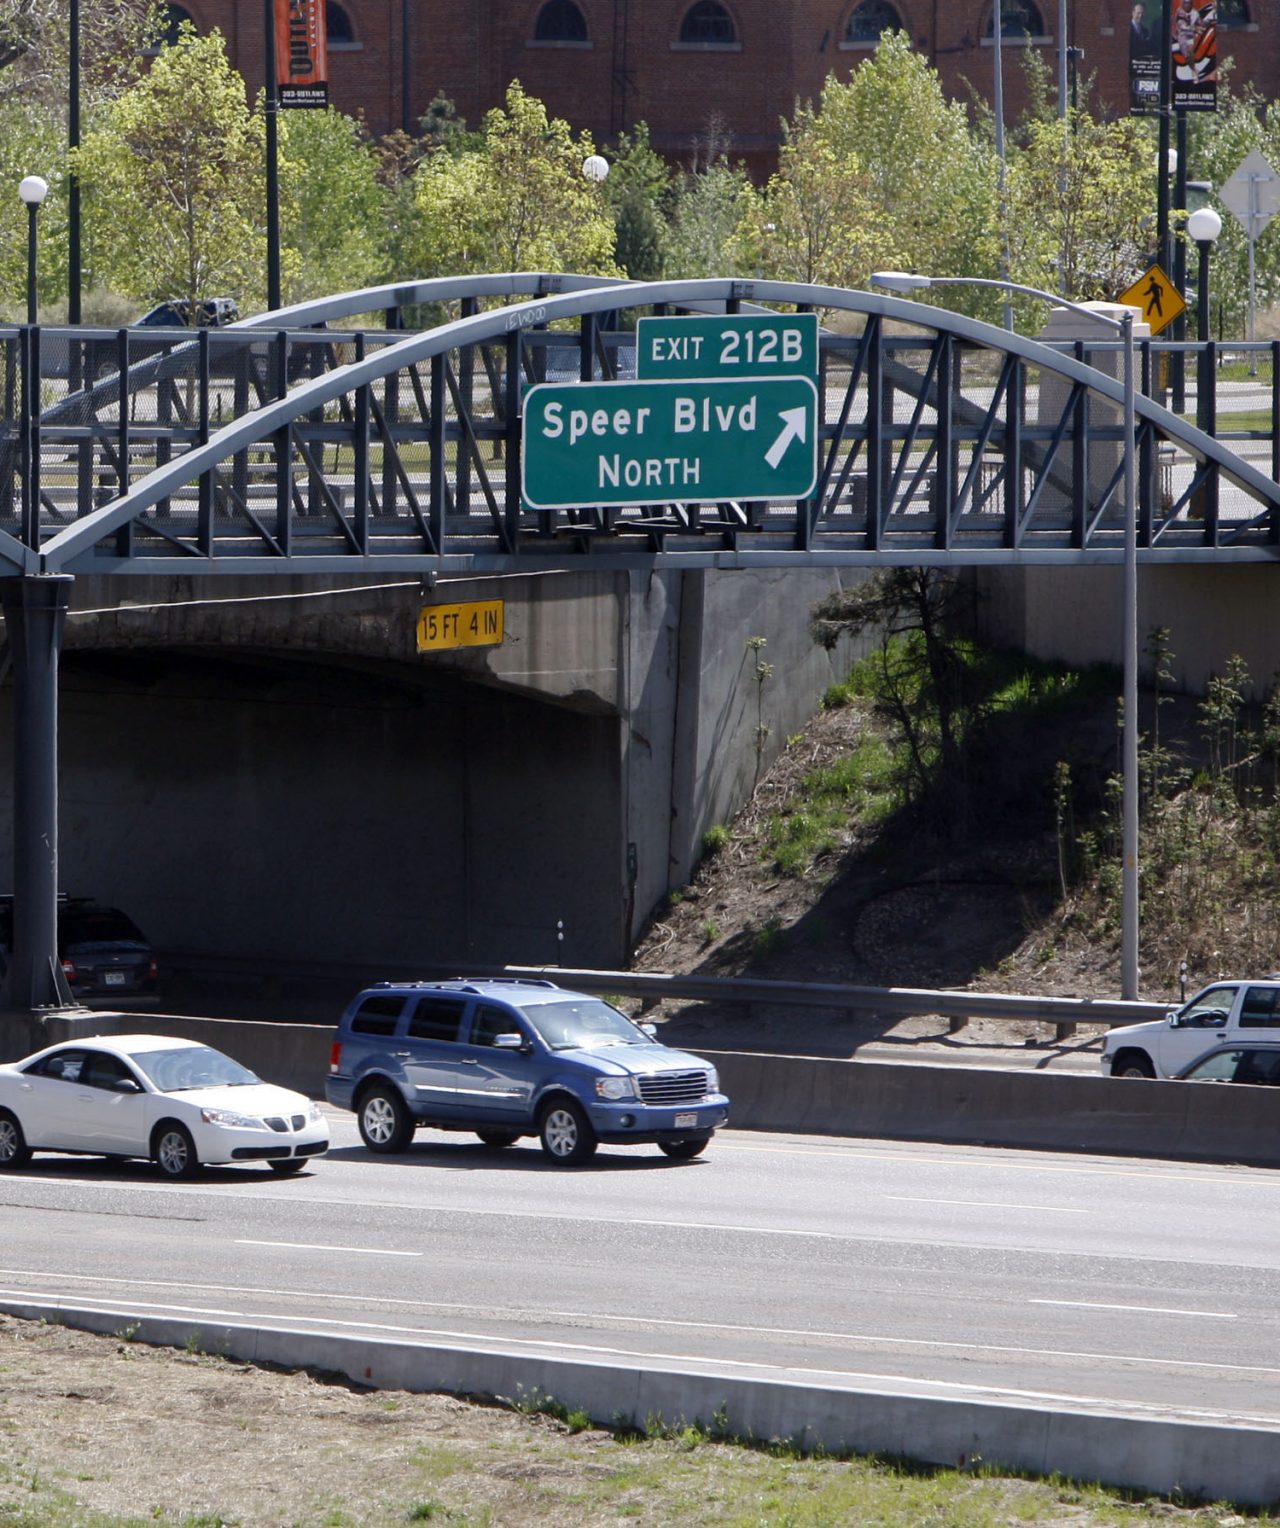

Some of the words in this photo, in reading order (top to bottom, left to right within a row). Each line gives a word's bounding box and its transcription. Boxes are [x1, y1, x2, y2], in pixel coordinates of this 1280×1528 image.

[652, 336, 704, 361] EXIT
[719, 328, 803, 364] 212B
[542, 401, 651, 446] Speer
[674, 395, 757, 433] Blvd
[598, 453, 701, 488] NORTH
[423, 614, 437, 641] 15
[443, 613, 459, 639] FT
[470, 611, 478, 636] 4
[484, 610, 497, 635] IN
